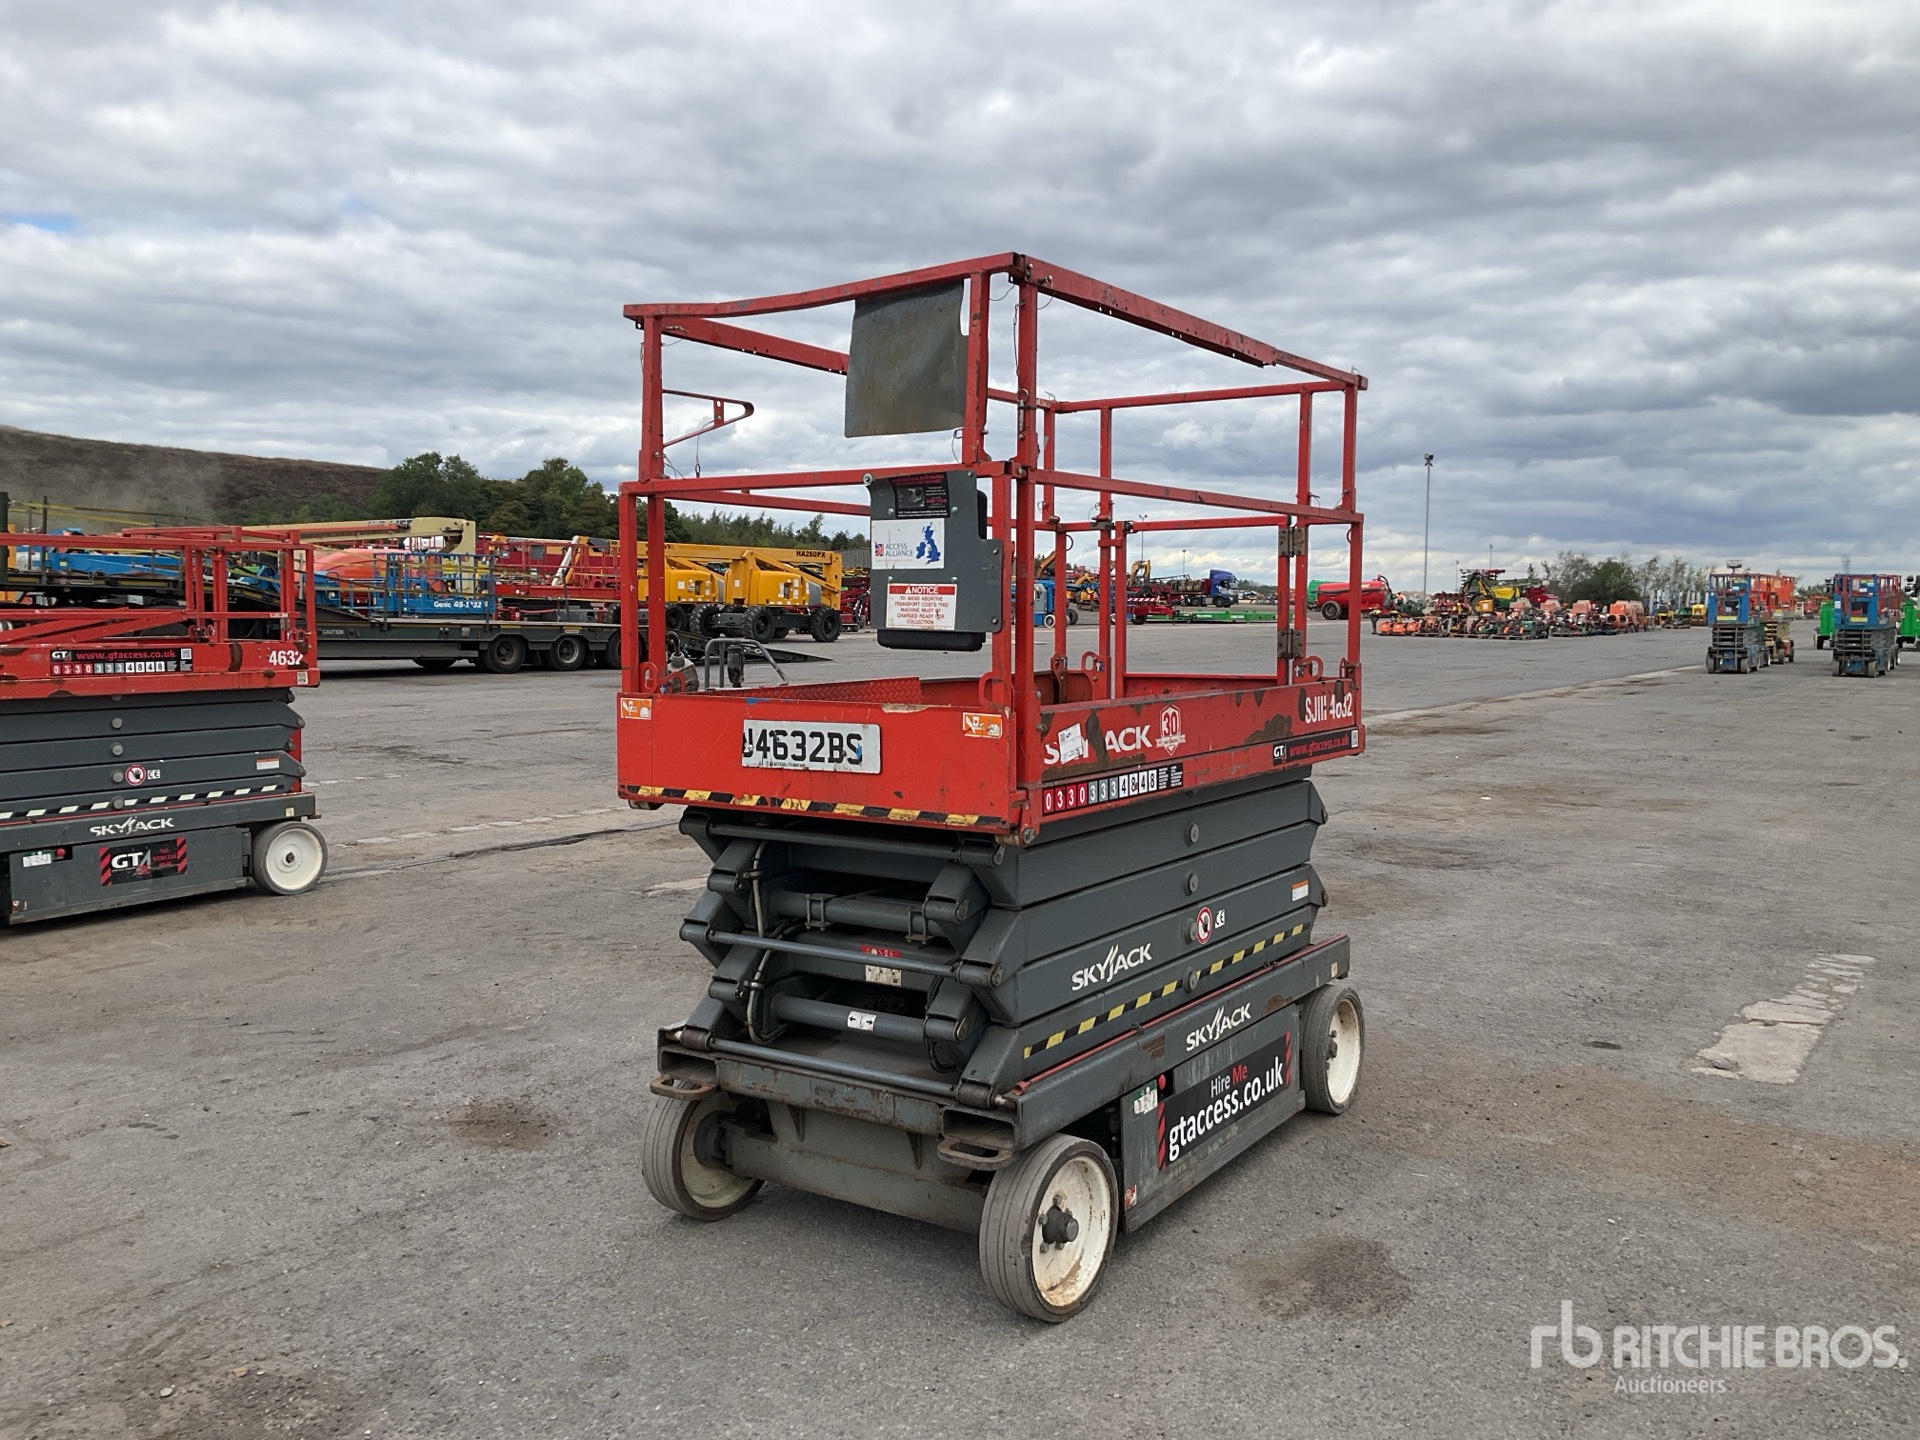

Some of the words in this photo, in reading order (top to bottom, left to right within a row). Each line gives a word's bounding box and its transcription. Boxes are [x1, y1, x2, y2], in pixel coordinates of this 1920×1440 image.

[911, 586, 939, 594] NOTICE
[76, 649, 176, 661] www.gtaccess.co.uk
[268, 650, 304, 666] 4632
[1162, 711, 1178, 736] 30
[1289, 734, 1350, 757] www.gtaccess.co.uk
[89, 816, 175, 836] SKYJACK
[1072, 943, 1153, 991] SKYJACK
[1186, 1002, 1252, 1052] SKYJACK
[1210, 1075, 1231, 1098] Hire
[1232, 1064, 1248, 1085] Me
[1169, 1056, 1283, 1162] gtaccess.co.uk
